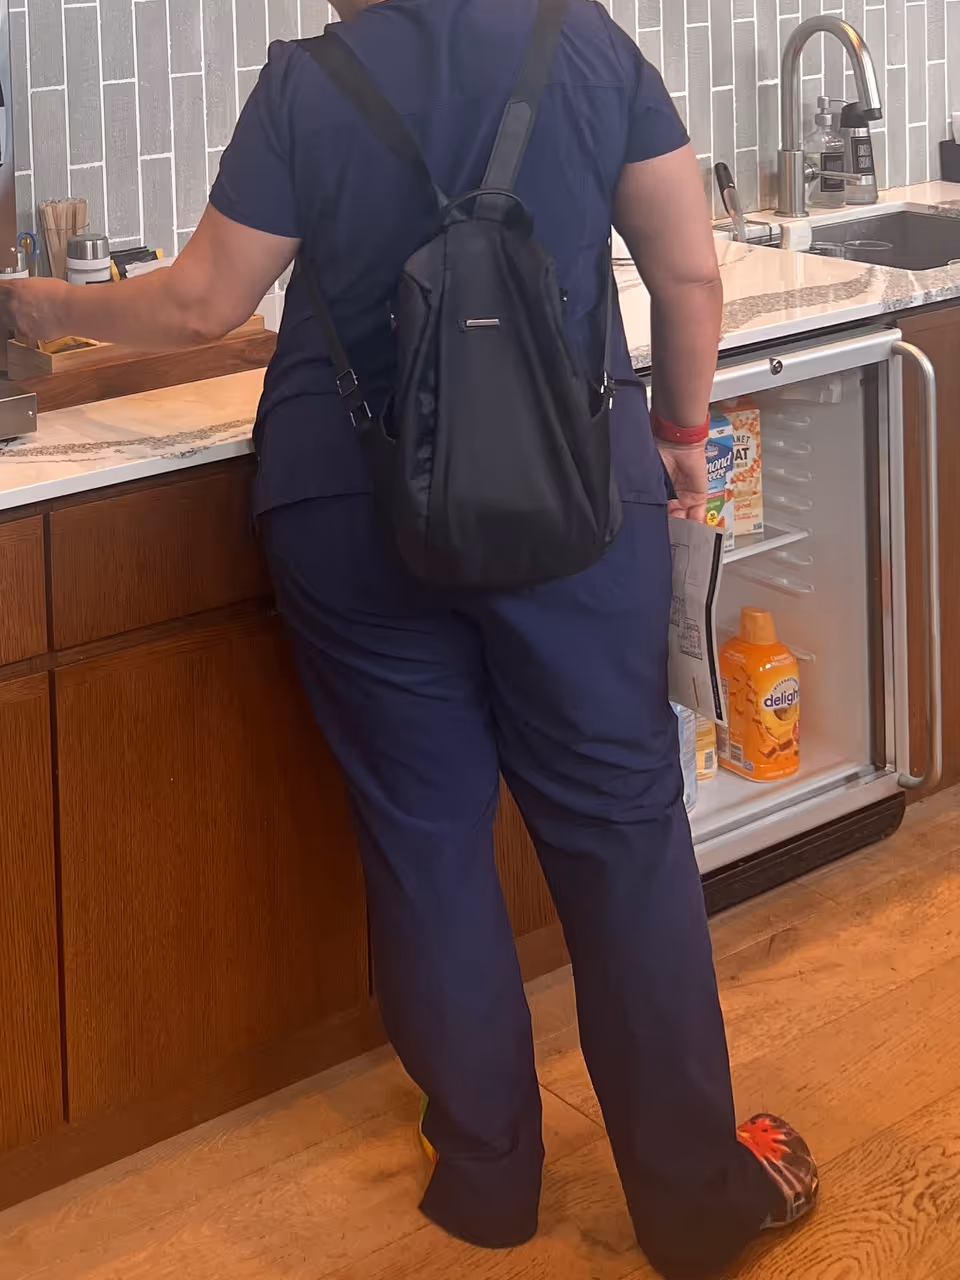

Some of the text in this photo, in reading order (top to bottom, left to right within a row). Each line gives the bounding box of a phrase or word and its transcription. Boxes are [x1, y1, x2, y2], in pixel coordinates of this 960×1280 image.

[707, 451, 733, 474] mond
[733, 447, 749, 461] AT
[707, 467, 726, 482] eeze
[764, 688, 799, 708] deligh
